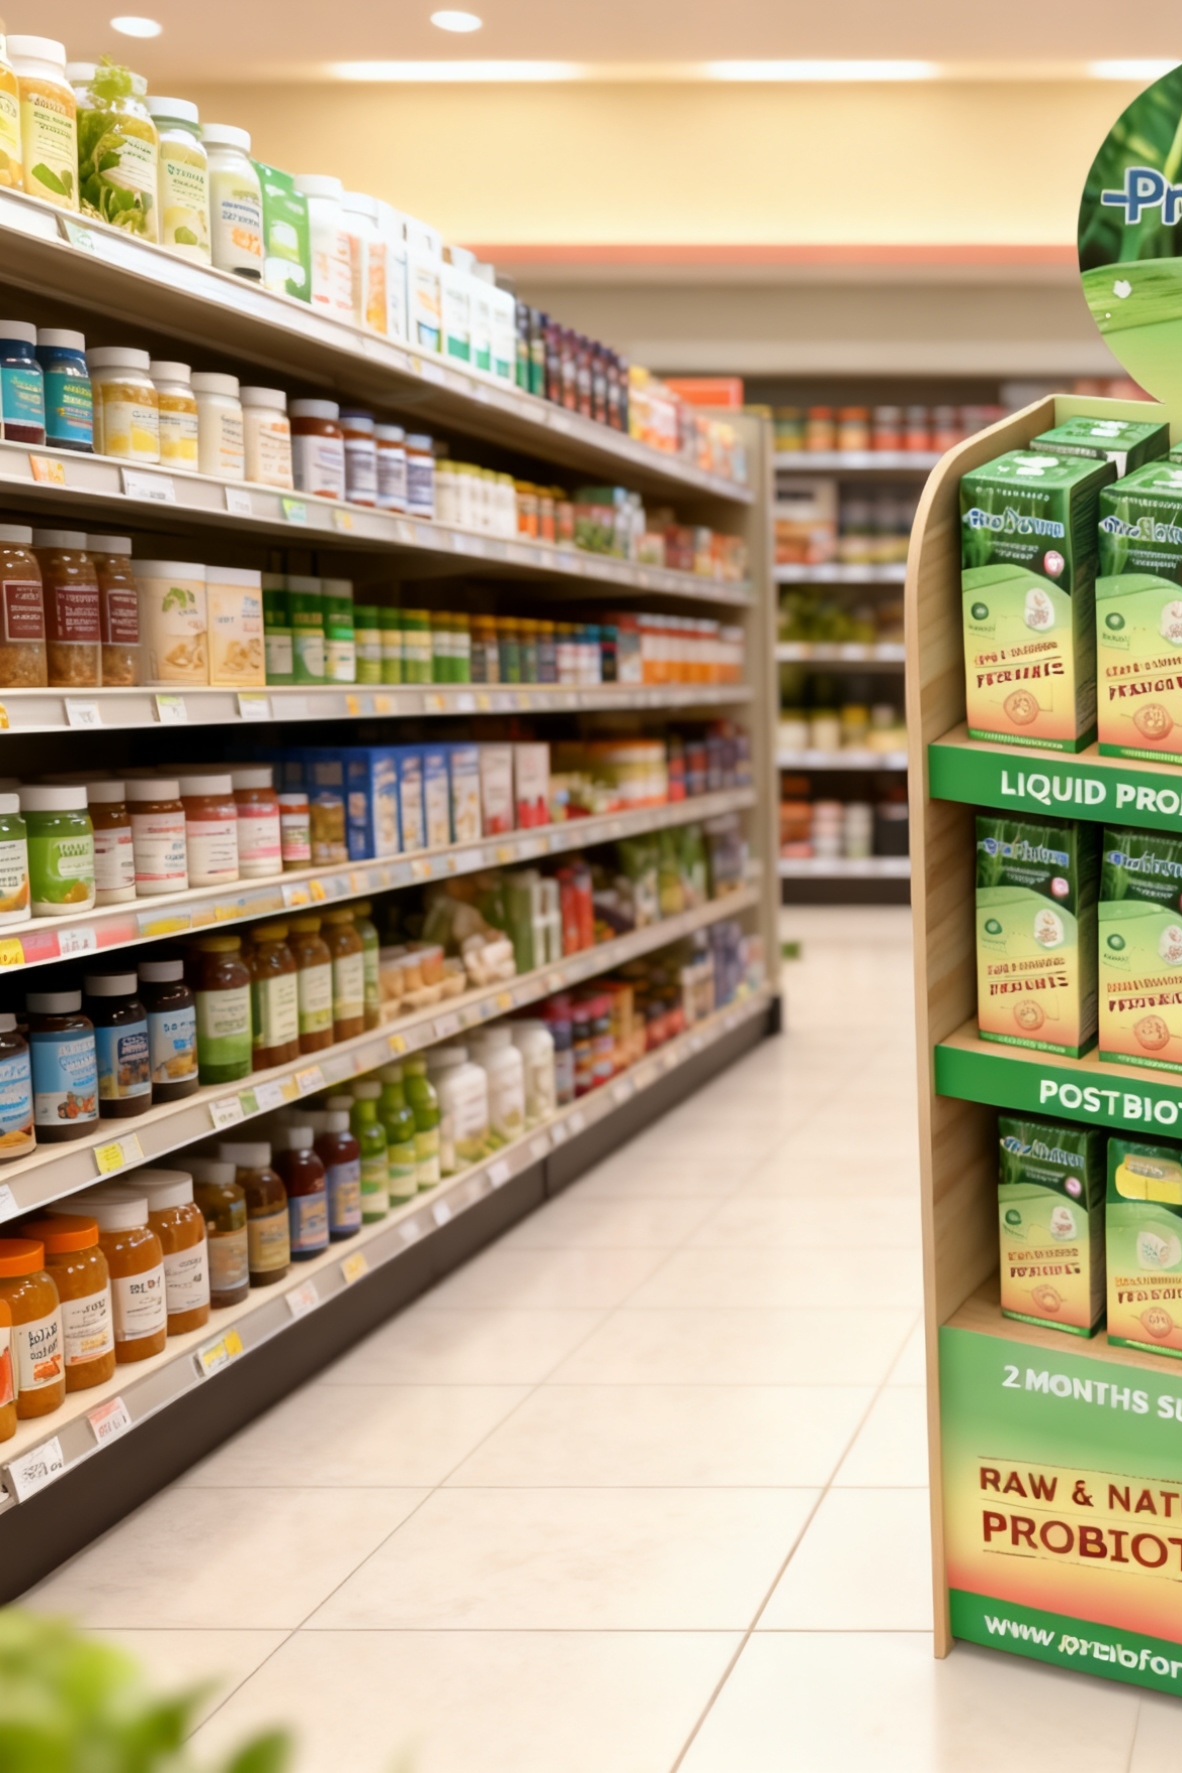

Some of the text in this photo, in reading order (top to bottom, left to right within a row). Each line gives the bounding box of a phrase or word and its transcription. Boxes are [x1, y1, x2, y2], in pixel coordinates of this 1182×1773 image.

[1001, 770, 1106, 806] LIQUID
[1001, 1365, 1022, 1389] 2
[1025, 1369, 1149, 1414] MONTHS
[978, 1466, 1058, 1502] RAW
[1071, 1479, 1094, 1507] &
